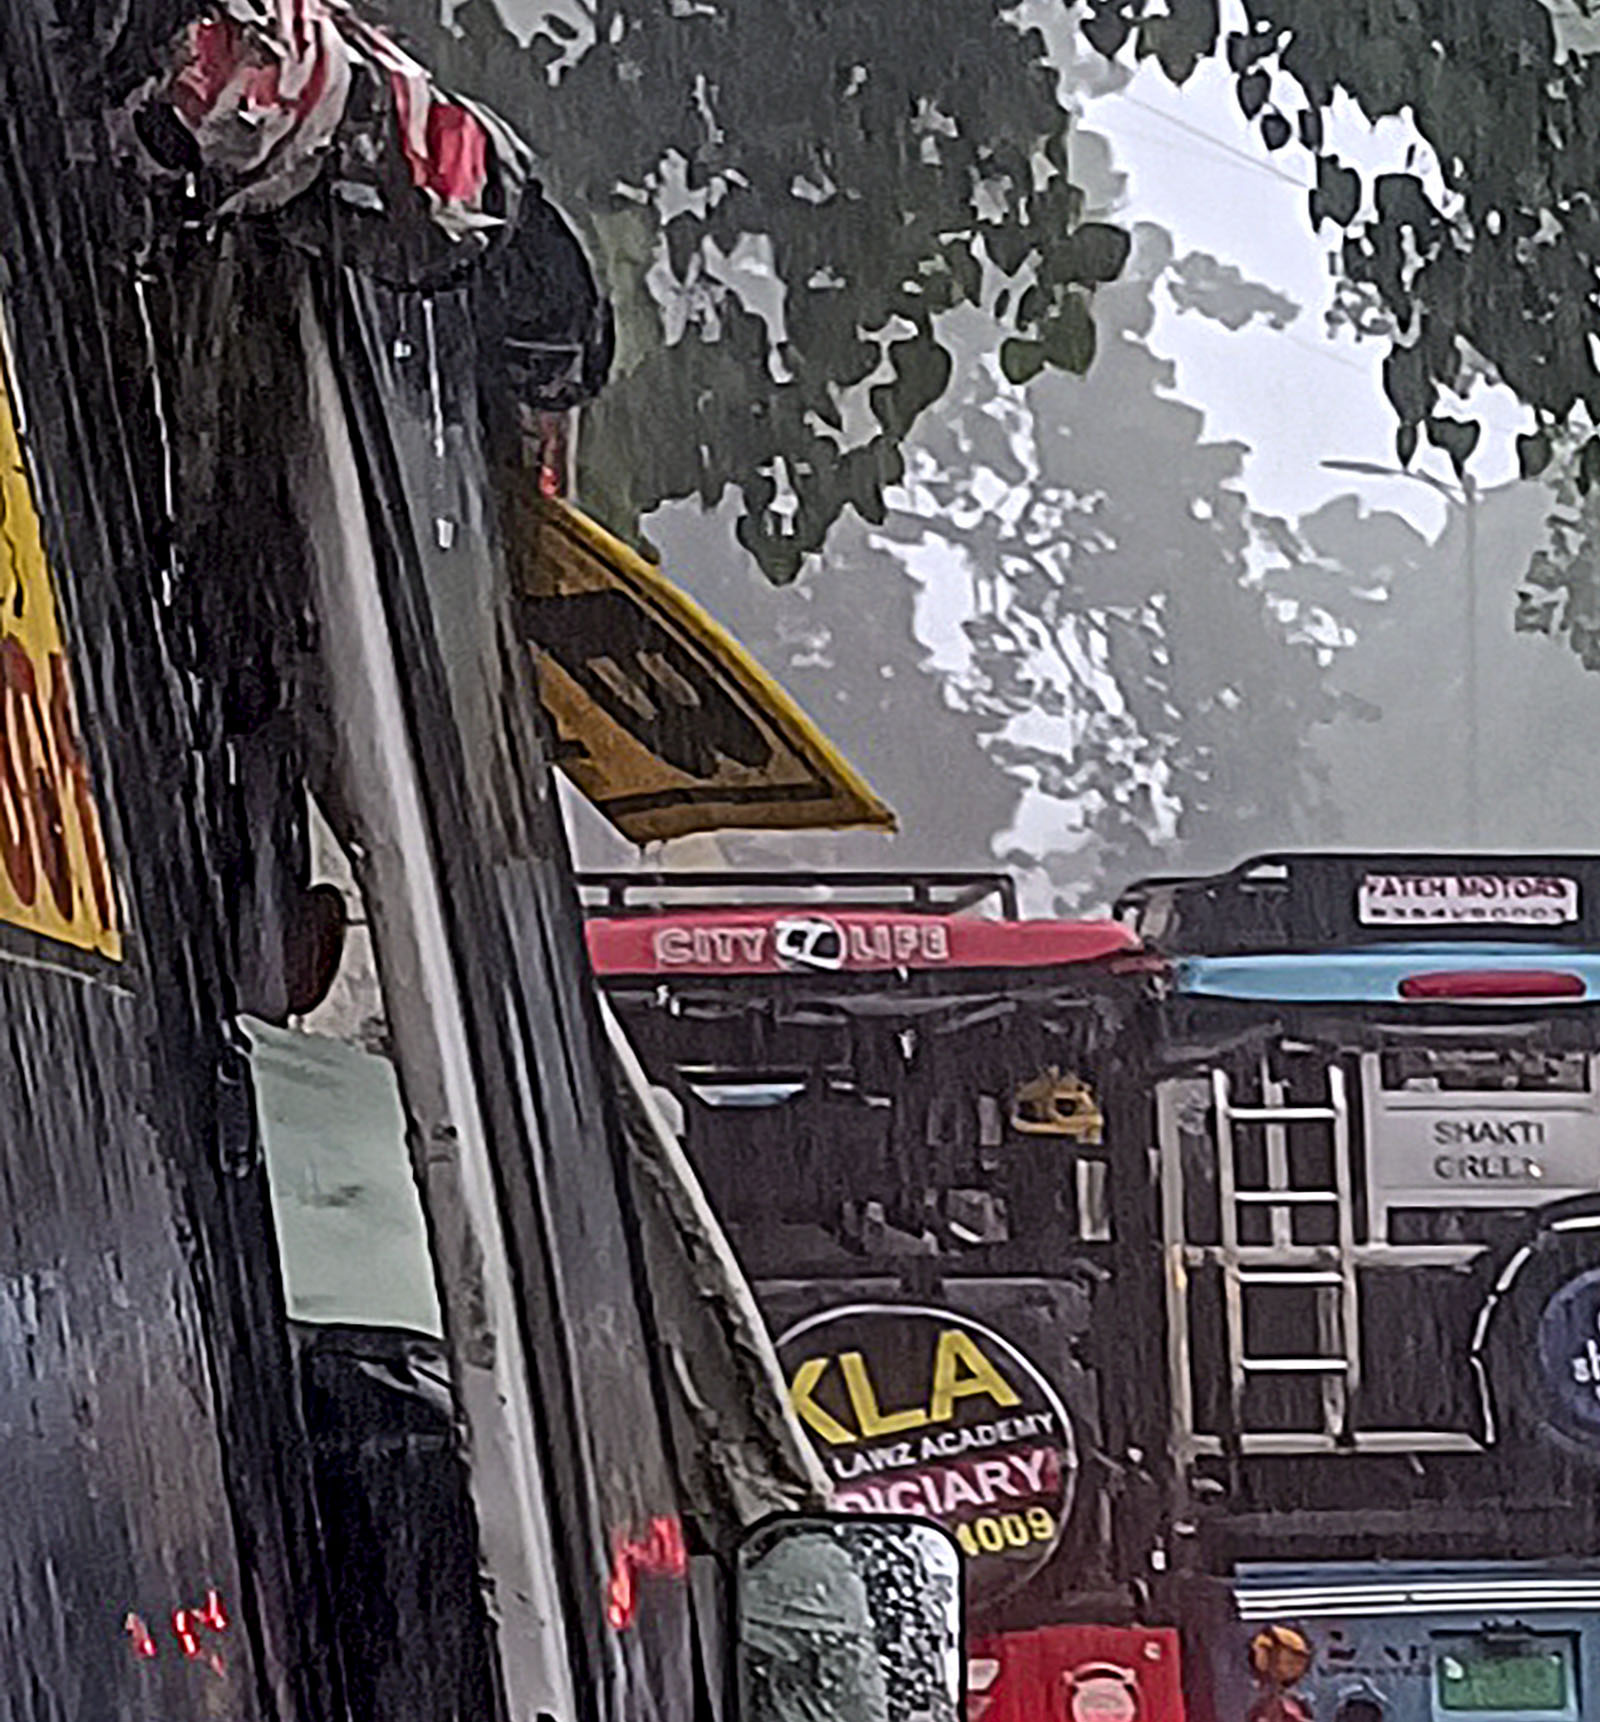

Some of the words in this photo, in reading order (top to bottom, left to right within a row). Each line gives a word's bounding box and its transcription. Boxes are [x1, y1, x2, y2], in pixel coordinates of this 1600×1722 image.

[653, 925, 768, 964] CITY
[849, 922, 948, 961] LIFE
[1433, 1119, 1545, 1145] SHAKTI
[919, 1411, 1054, 1461] ACADEMY
[827, 1448, 1047, 1516] DICIARY
